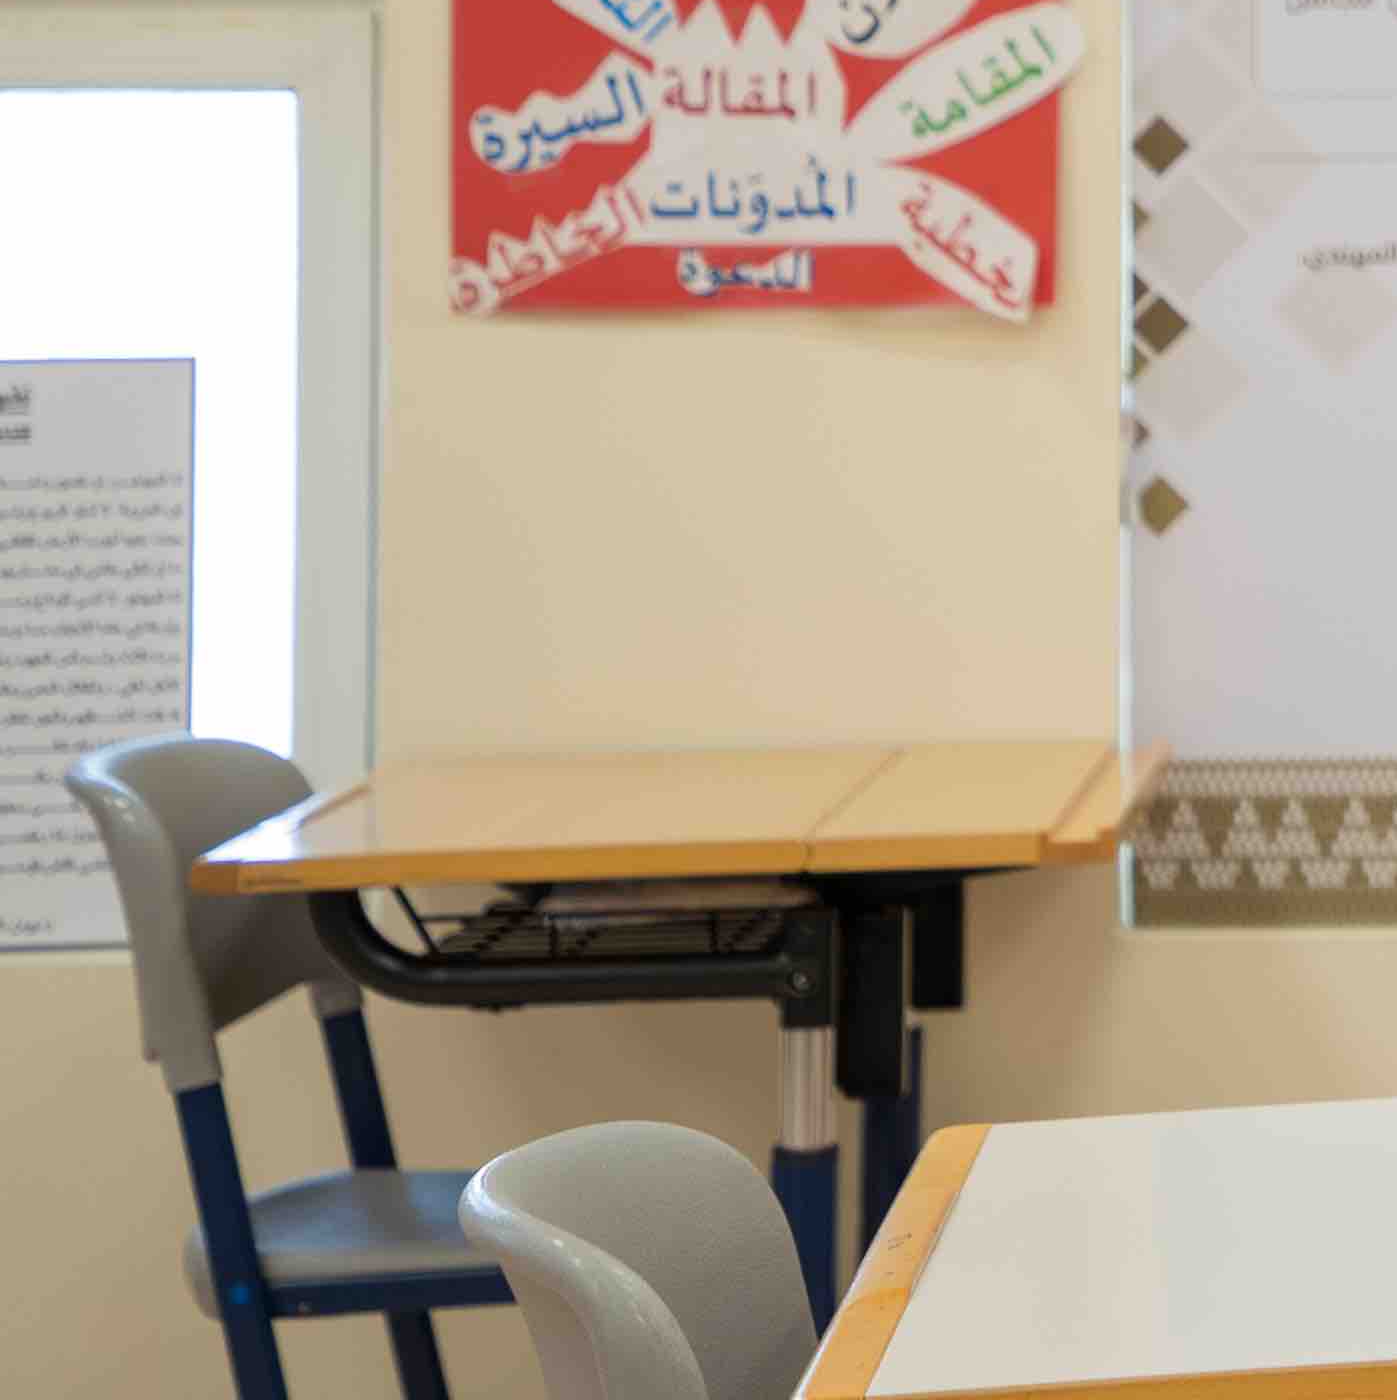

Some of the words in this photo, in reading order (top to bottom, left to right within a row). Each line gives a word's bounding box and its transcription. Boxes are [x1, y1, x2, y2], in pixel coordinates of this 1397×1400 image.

[477, 70, 647, 173] السيرة
[660, 62, 818, 122] المقالة
[898, 26, 1058, 143] المقامة
